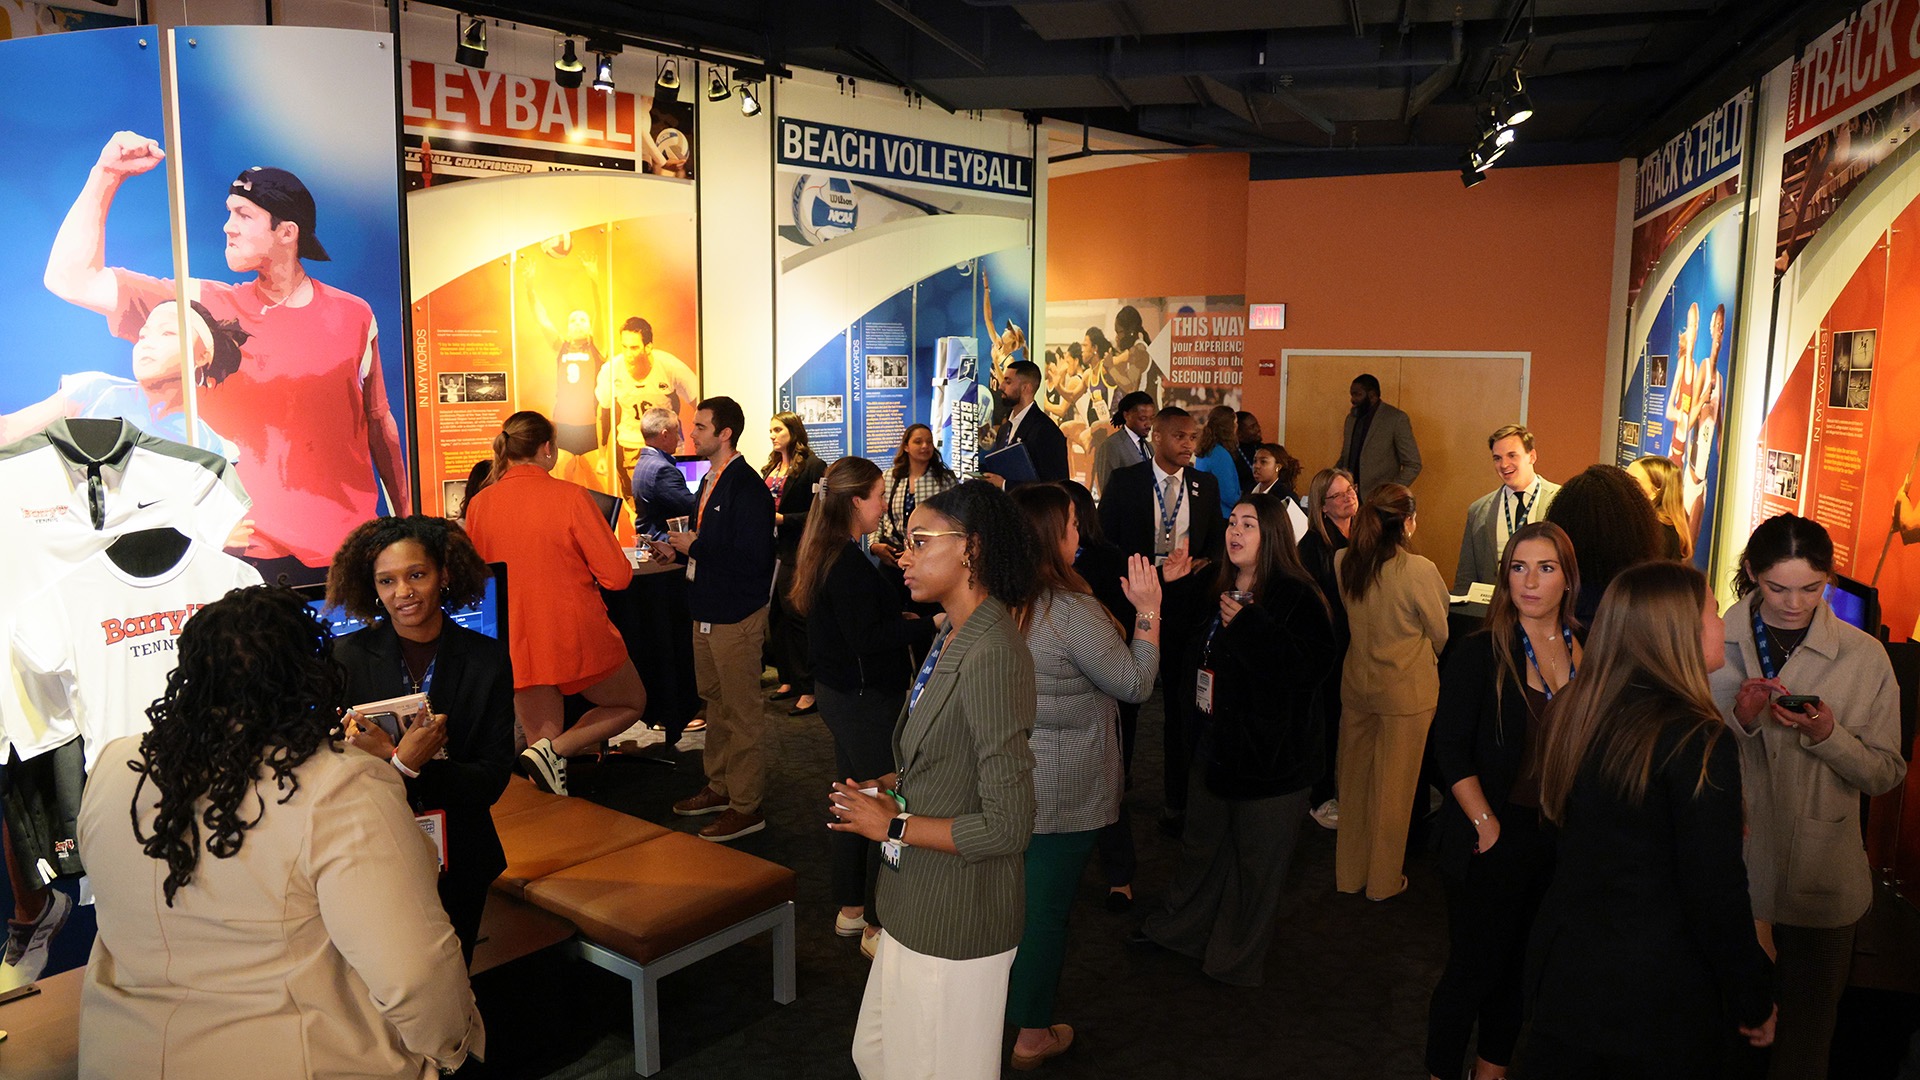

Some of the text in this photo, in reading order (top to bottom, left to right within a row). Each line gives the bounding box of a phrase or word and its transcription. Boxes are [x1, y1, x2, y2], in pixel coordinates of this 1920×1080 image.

[1798, 0, 1897, 124] TRACK
[401, 58, 632, 144] LEYBALL
[454, 157, 532, 173] CHAMPIONSHIP
[783, 122, 1028, 192] BEACH VOLLEYBALL
[1640, 131, 1684, 210] TRACK
[1682, 128, 1693, 183] &
[1693, 86, 1753, 177] FIELD
[827, 209, 854, 224] NCAA
[829, 194, 853, 206] Wilson
[1173, 316, 1245, 337] THIS WAY
[1255, 306, 1281, 327] EXIT
[1172, 342, 1193, 353] your
[1172, 356, 1216, 366] continues
[1217, 356, 1229, 367] on
[416, 329, 429, 408] IN MY WORDS
[852, 339, 861, 402] IN MY WORDS
[1171, 370, 1211, 384] SECOND
[1813, 331, 1829, 443] IN MY WORDS
[951, 400, 961, 479] CHAMPIONSHIP
[960, 401, 973, 451] BEACH
[130, 638, 178, 658] TENN
